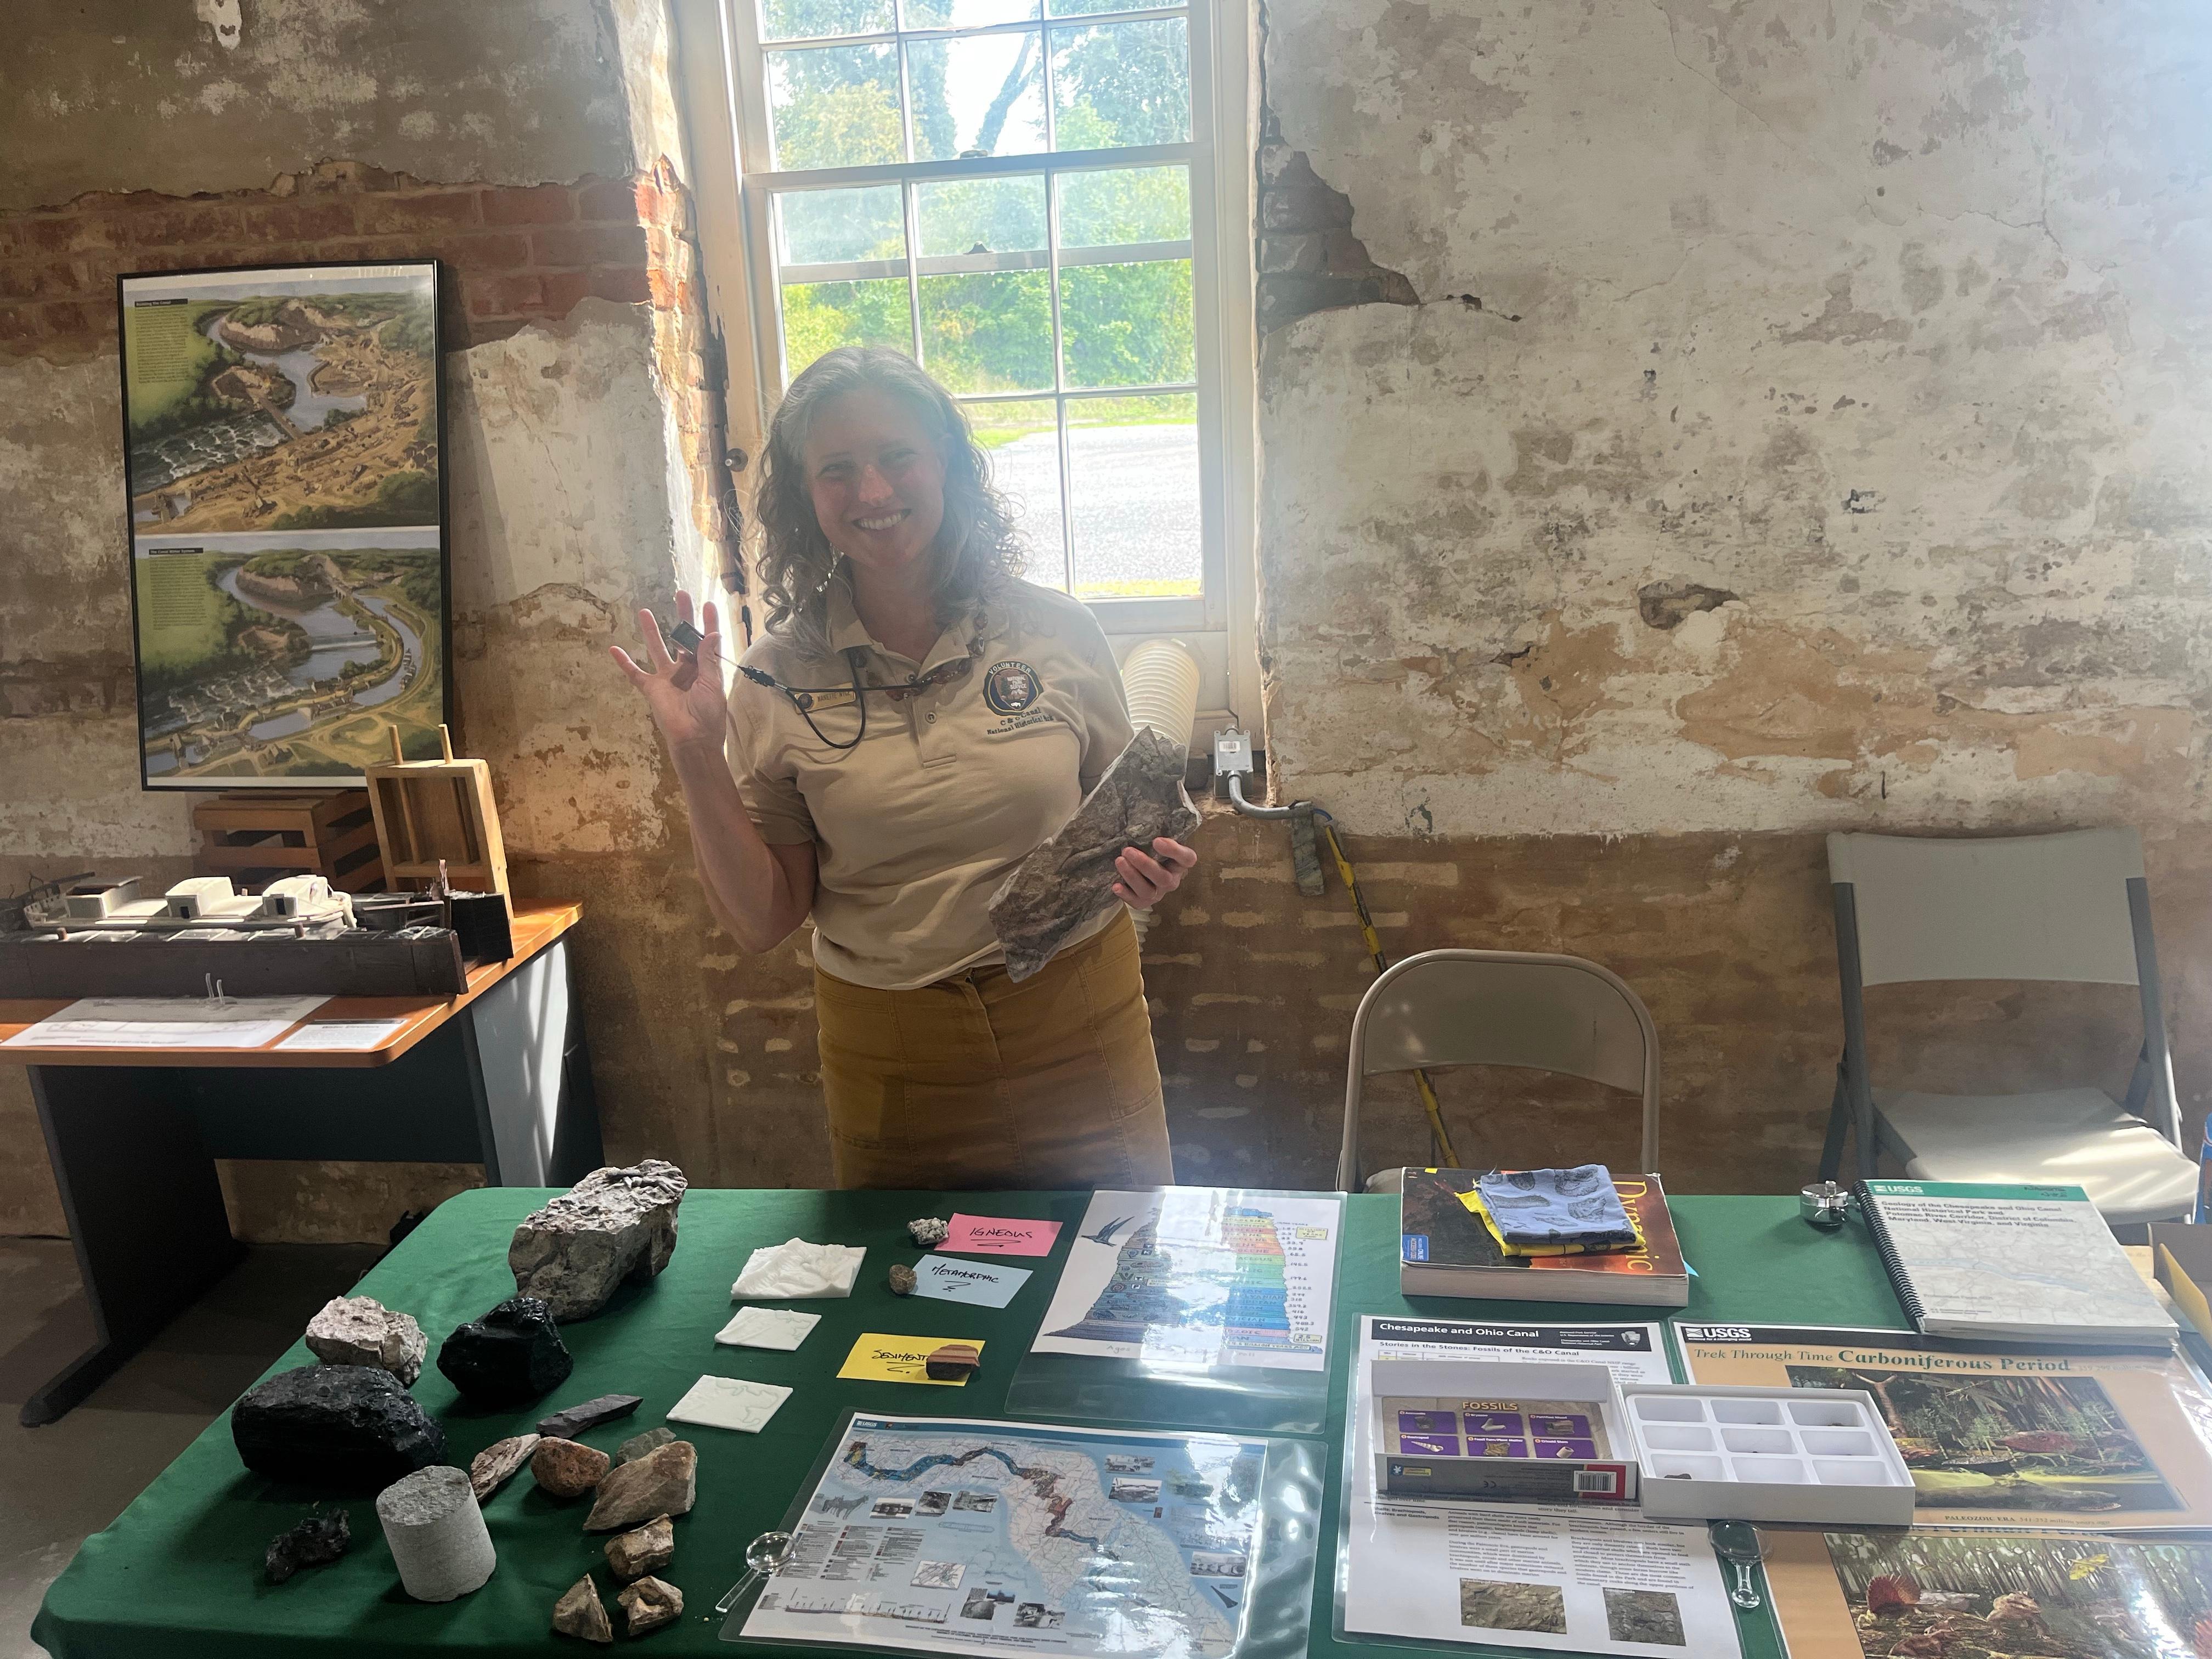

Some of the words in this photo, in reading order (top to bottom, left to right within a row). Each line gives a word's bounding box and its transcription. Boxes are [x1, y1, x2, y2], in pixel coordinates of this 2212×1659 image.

[989, 662, 1031, 675] VOLUNTEER
[1020, 707, 1042, 718] Canal
[987, 726, 1014, 735] National
[1015, 716, 1042, 729] Historical
[969, 1227, 1034, 1238] IGNEOUS
[932, 1263, 1000, 1283] METAMORPHIC
[1379, 1323, 1448, 1333] Chesapeake
[1705, 1328, 1751, 1338] USGS
[871, 1349, 929, 1362] SEDIMENT
[1694, 1348, 1726, 1359] Trek
[1730, 1349, 1792, 1362] Through
[1797, 1351, 1833, 1361] Time
[1838, 1350, 1993, 1370] Carboniferous
[2000, 1357, 2071, 1372] Period
[1462, 1401, 1519, 1411] FOSSILS
